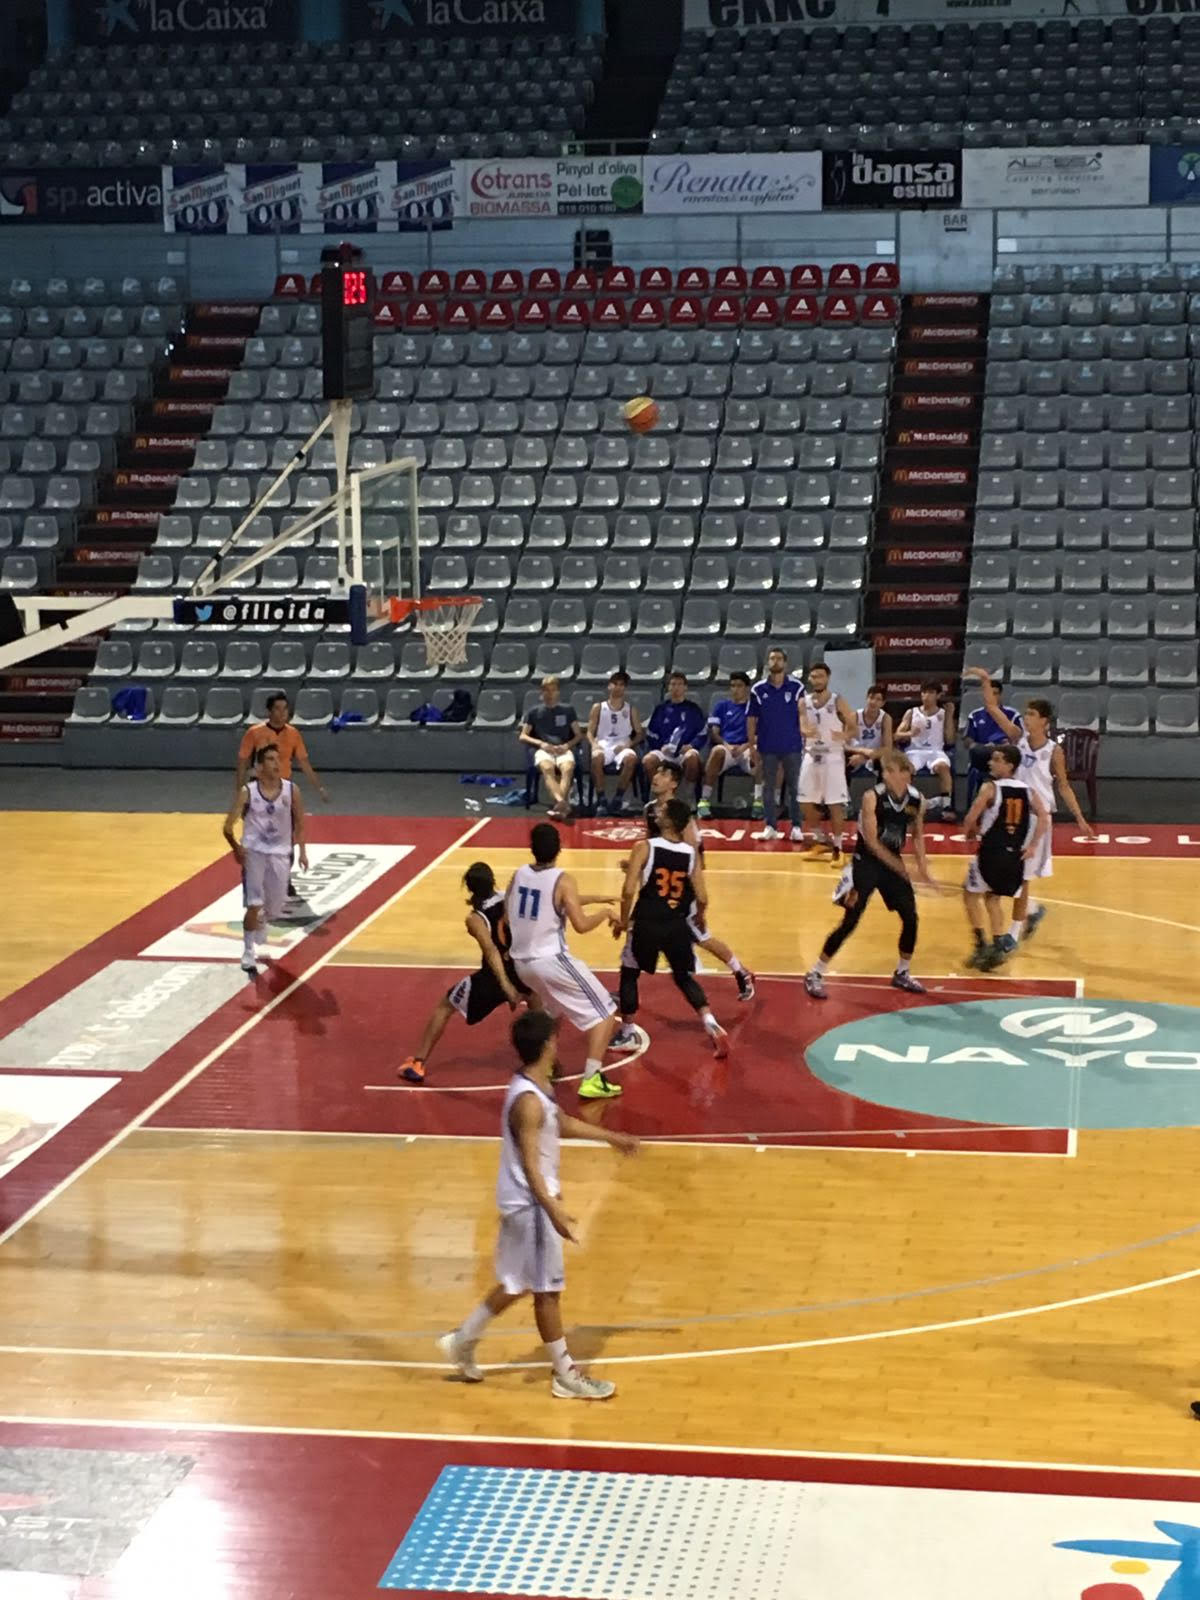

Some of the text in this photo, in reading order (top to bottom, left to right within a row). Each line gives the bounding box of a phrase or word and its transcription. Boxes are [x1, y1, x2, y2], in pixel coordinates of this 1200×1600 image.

[557, 162, 593, 178] Pinyol
[650, 161, 768, 195] Renata
[852, 158, 955, 184] dansa
[893, 182, 955, 198] estudi
[470, 201, 551, 215] BIOMASSA
[944, 215, 968, 226] BAR
[223, 602, 325, 621] @flleida
[655, 867, 685, 900] 35
[518, 886, 541, 920] 11
